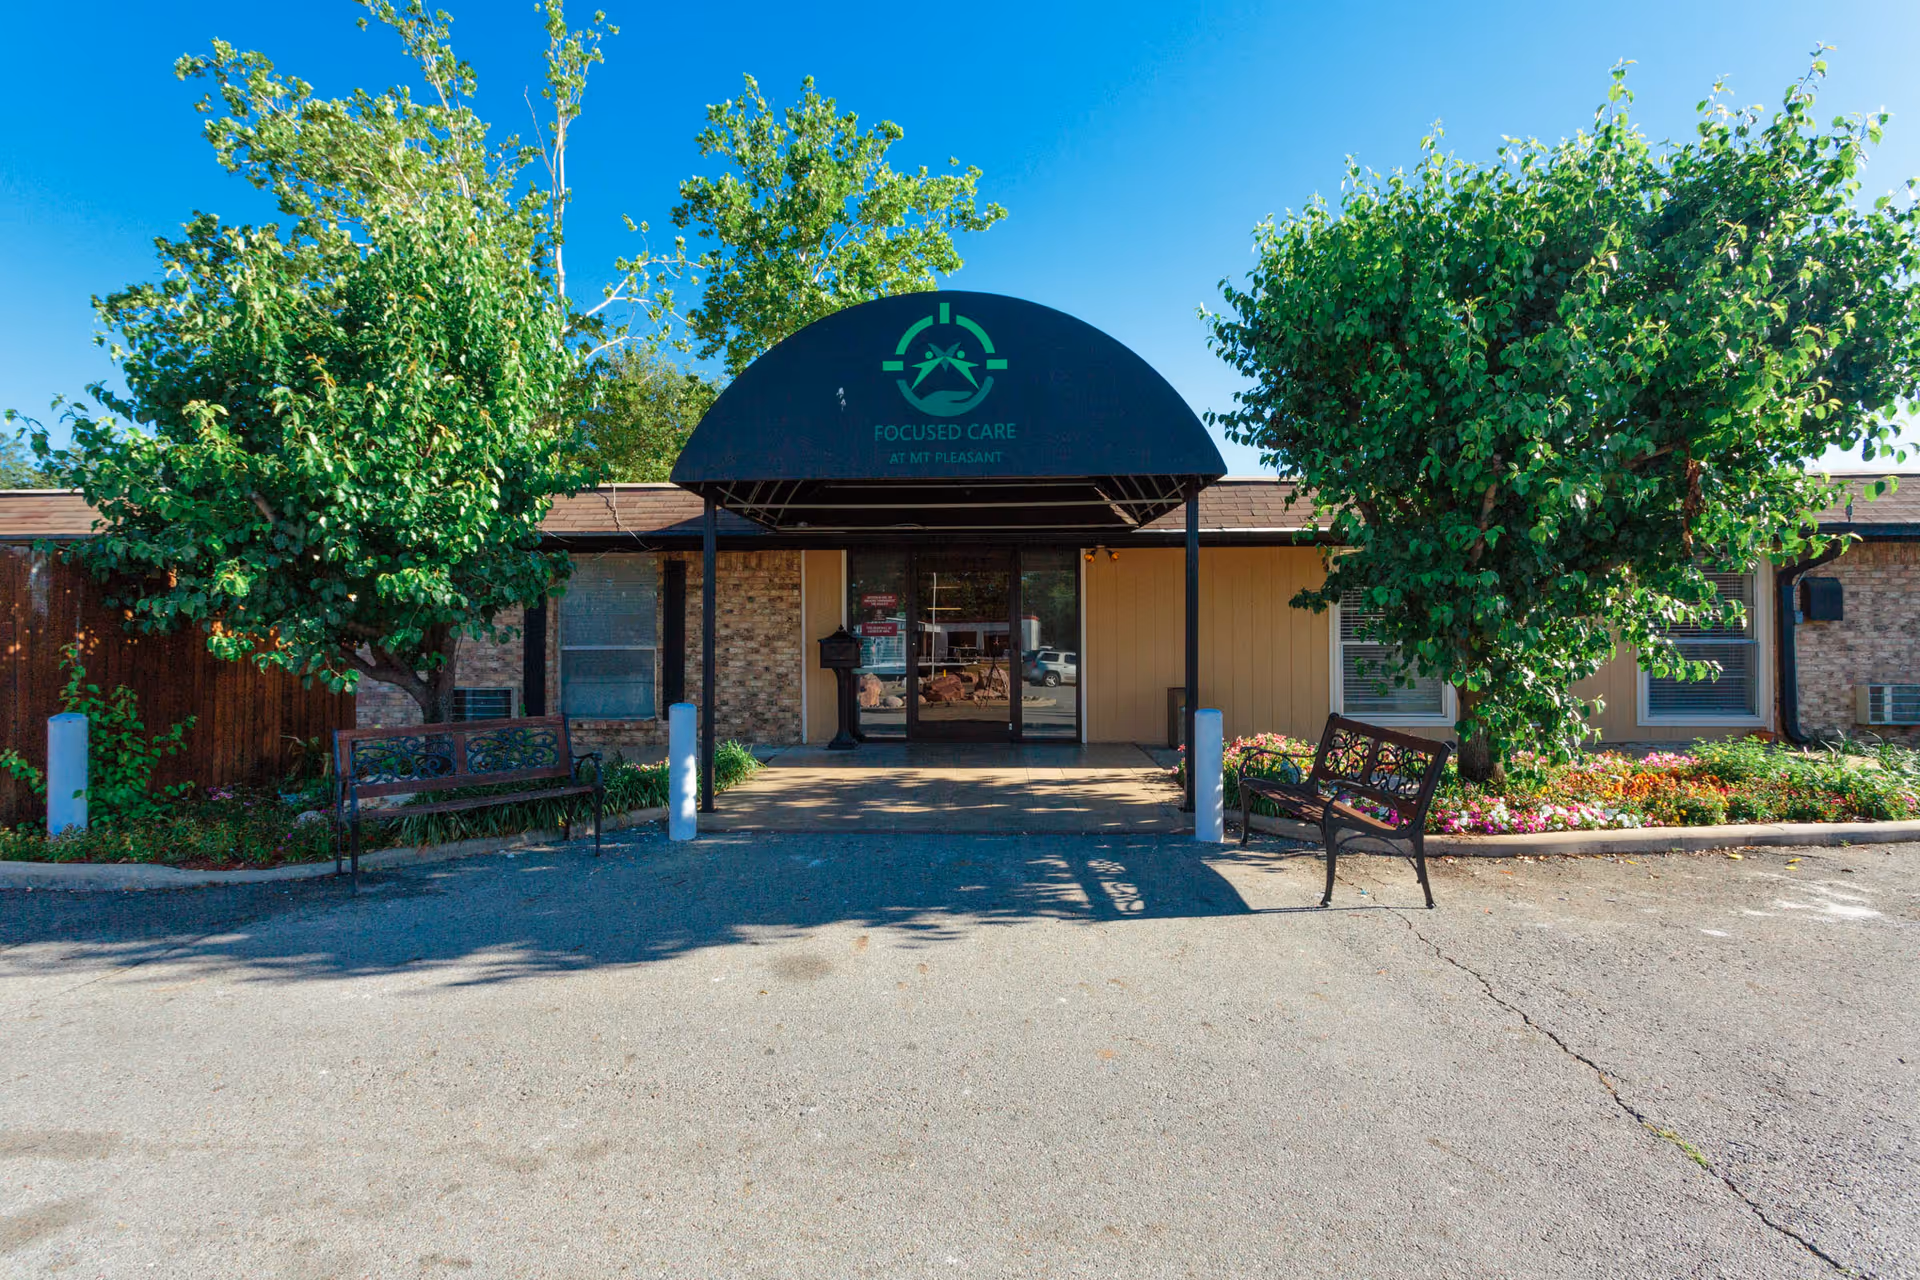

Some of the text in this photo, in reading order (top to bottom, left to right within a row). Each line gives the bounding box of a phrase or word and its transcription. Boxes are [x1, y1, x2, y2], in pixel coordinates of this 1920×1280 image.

[874, 423, 1017, 441] FOCUSED CARE
[889, 451, 1003, 464] AT MT PLEASANT
